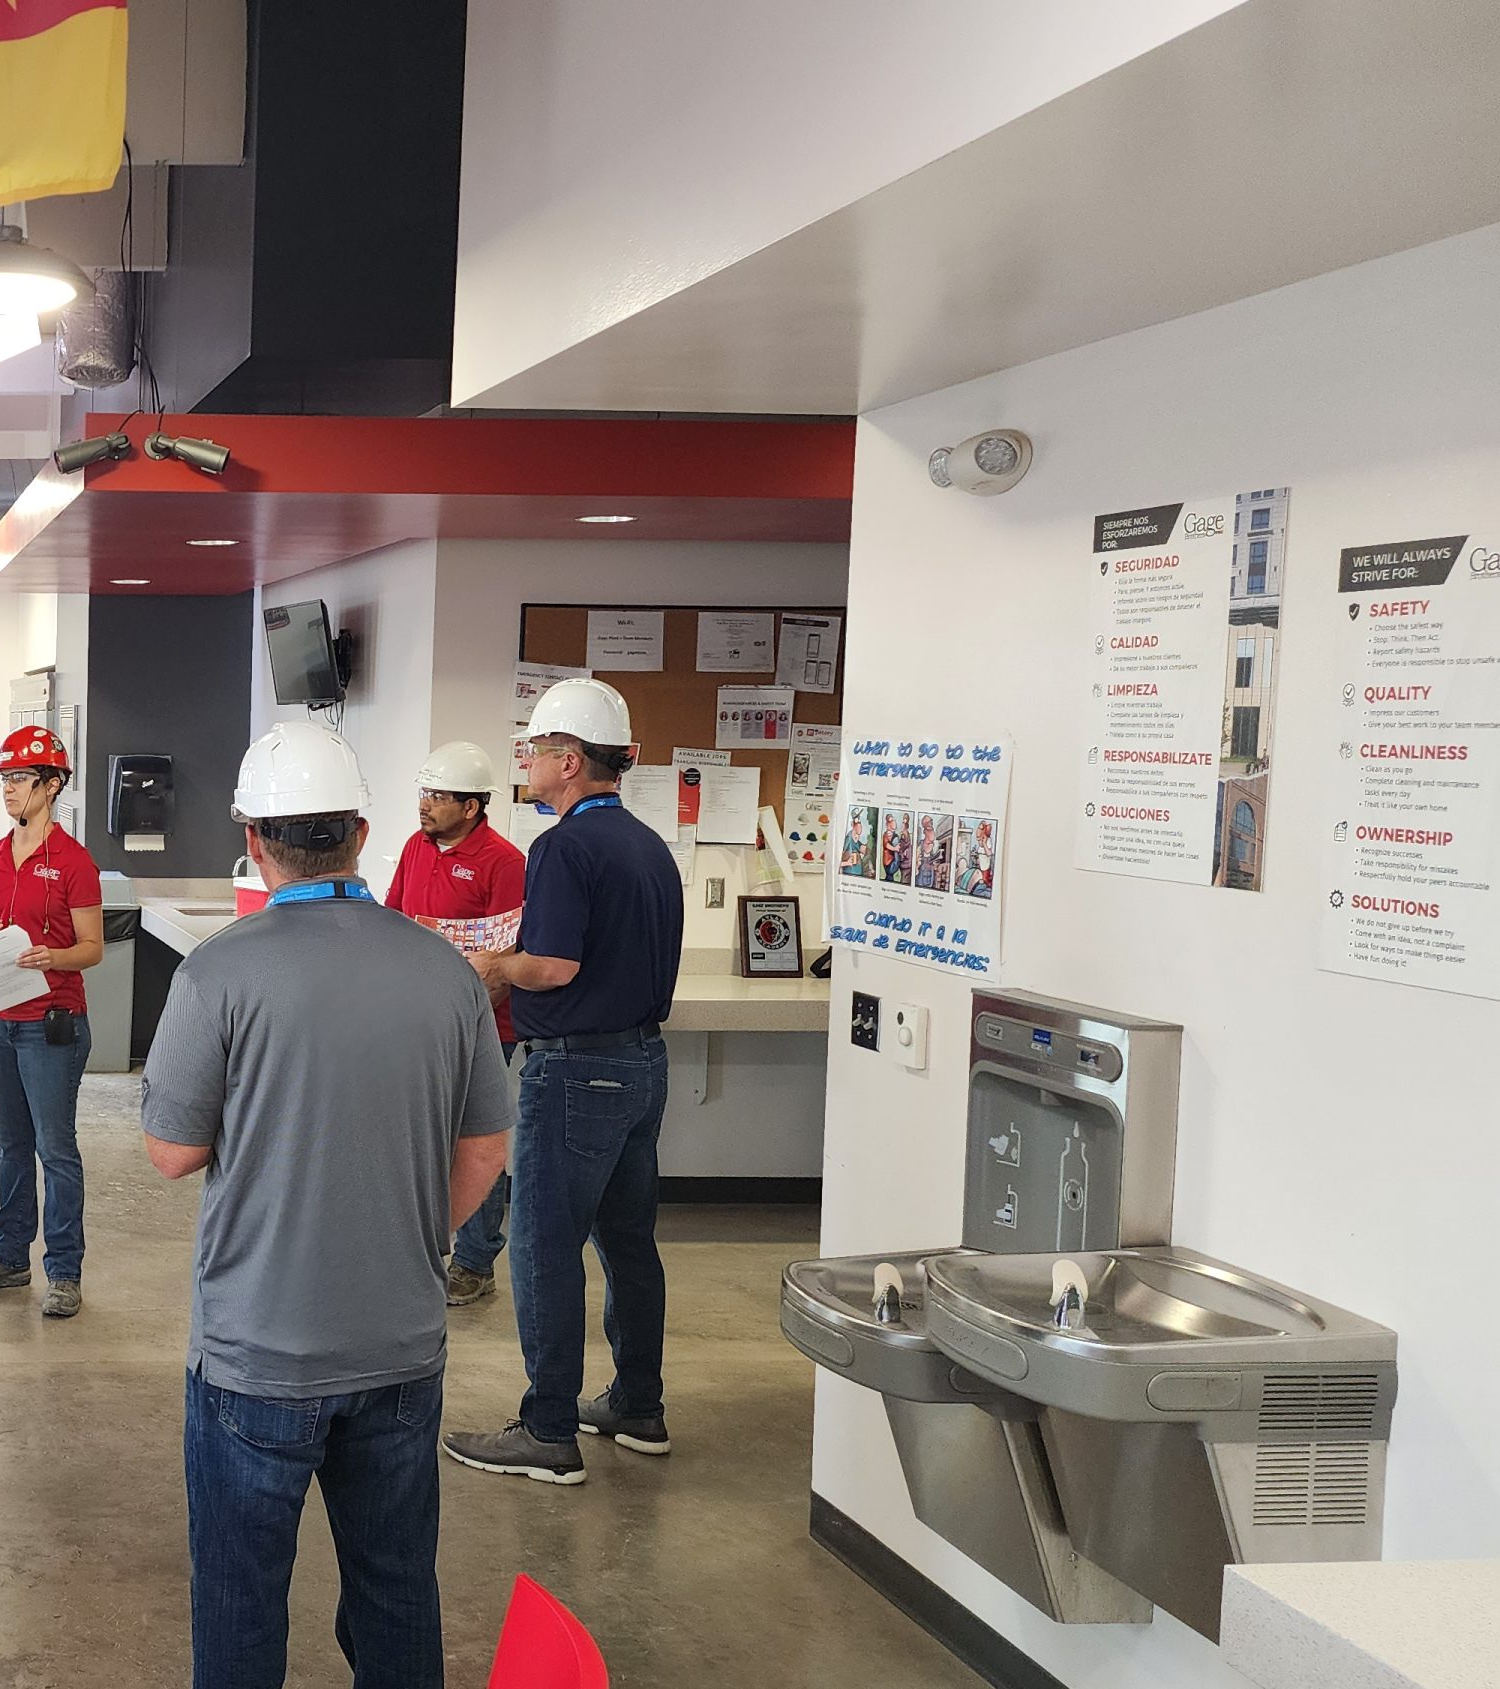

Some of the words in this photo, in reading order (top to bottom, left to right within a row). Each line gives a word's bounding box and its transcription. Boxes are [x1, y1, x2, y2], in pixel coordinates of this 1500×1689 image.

[1102, 517, 1132, 530] SIEMPRE
[1134, 516, 1149, 526] NOS
[1184, 512, 1224, 538] Gage
[1102, 524, 1158, 540] ESFORZAREMOS
[1102, 540, 1118, 550] POR:
[1114, 555, 1180, 574] SEGURIDAD
[1352, 556, 1372, 568] WE
[1372, 554, 1400, 566] WILL
[1400, 548, 1451, 564] ALWAYS
[1350, 570, 1390, 584] STRIVE
[1369, 600, 1430, 618] SAFETY
[1110, 635, 1159, 650] CALIDAD
[1107, 683, 1158, 697] LIMPIEZA
[1364, 686, 1432, 704] QUALITY
[898, 742, 912, 758] to
[918, 742, 939, 759] go
[946, 744, 964, 760] to
[972, 744, 1002, 762] the
[1104, 750, 1212, 766] RESPONSABILIZATE
[1360, 743, 1468, 761] CLEANLINESS
[1366, 765, 1382, 773] Clean
[1365, 776, 1394, 786] Complete
[1364, 788, 1380, 797] tasks
[1364, 800, 1380, 808] Treat
[1100, 805, 1170, 822] SOLUCIONES
[1356, 825, 1454, 846] OWNERSHIP
[1360, 846, 1391, 857] Recognize
[1392, 850, 1423, 859] successes
[1360, 858, 1374, 867] Take
[1376, 860, 1417, 872] responsibility
[1359, 870, 1396, 882] Respectfully
[1398, 874, 1412, 883] hold
[1350, 894, 1440, 918] SOLUTIONS
[1354, 929, 1372, 938] Come
[872, 934, 889, 949] de
